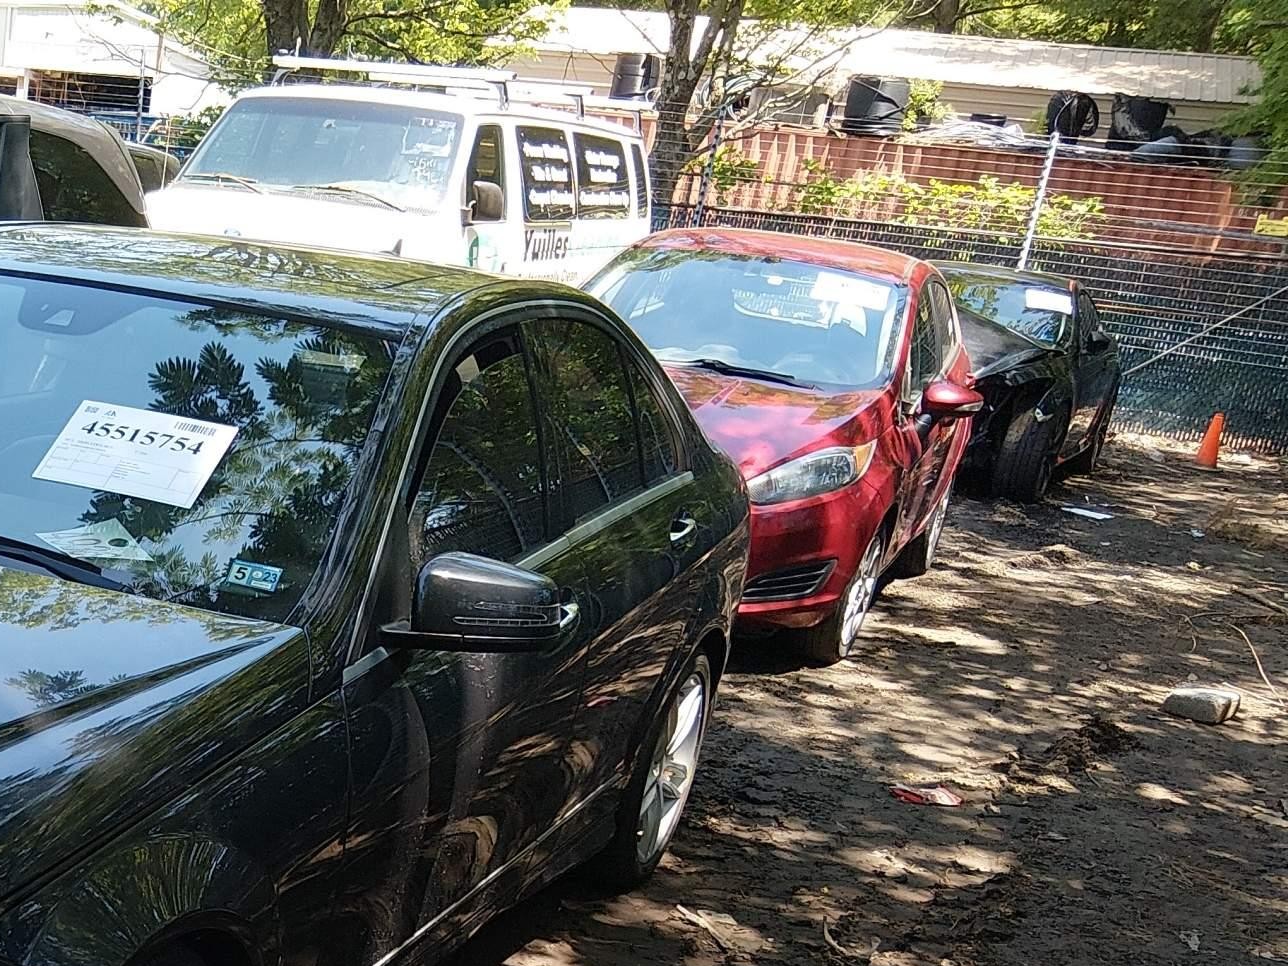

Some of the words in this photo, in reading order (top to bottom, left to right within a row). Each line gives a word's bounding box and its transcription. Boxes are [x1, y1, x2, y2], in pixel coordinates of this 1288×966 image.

[523, 228, 569, 263] Yuilles
[80, 421, 205, 455] 45515754
[234, 566, 249, 581] 5
[263, 571, 278, 584] 23
